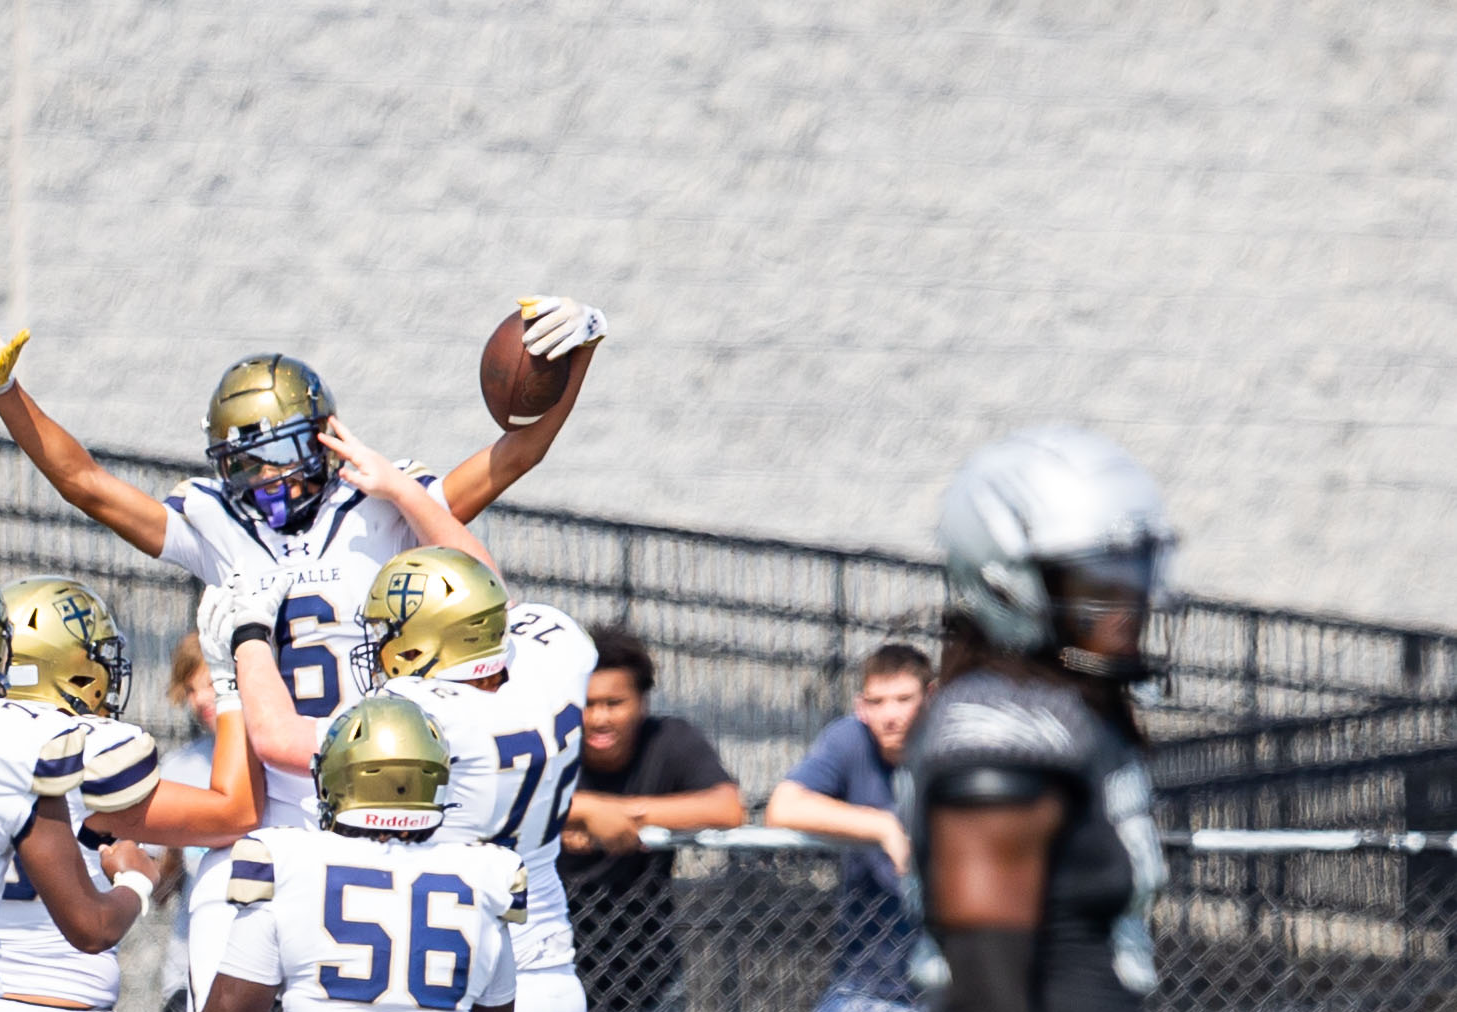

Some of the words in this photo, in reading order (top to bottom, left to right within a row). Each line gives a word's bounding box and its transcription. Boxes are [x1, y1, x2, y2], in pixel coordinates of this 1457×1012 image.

[277, 592, 342, 718] 6
[365, 813, 430, 827] Riddell
[484, 702, 583, 851] 72
[317, 863, 477, 1011] 56
